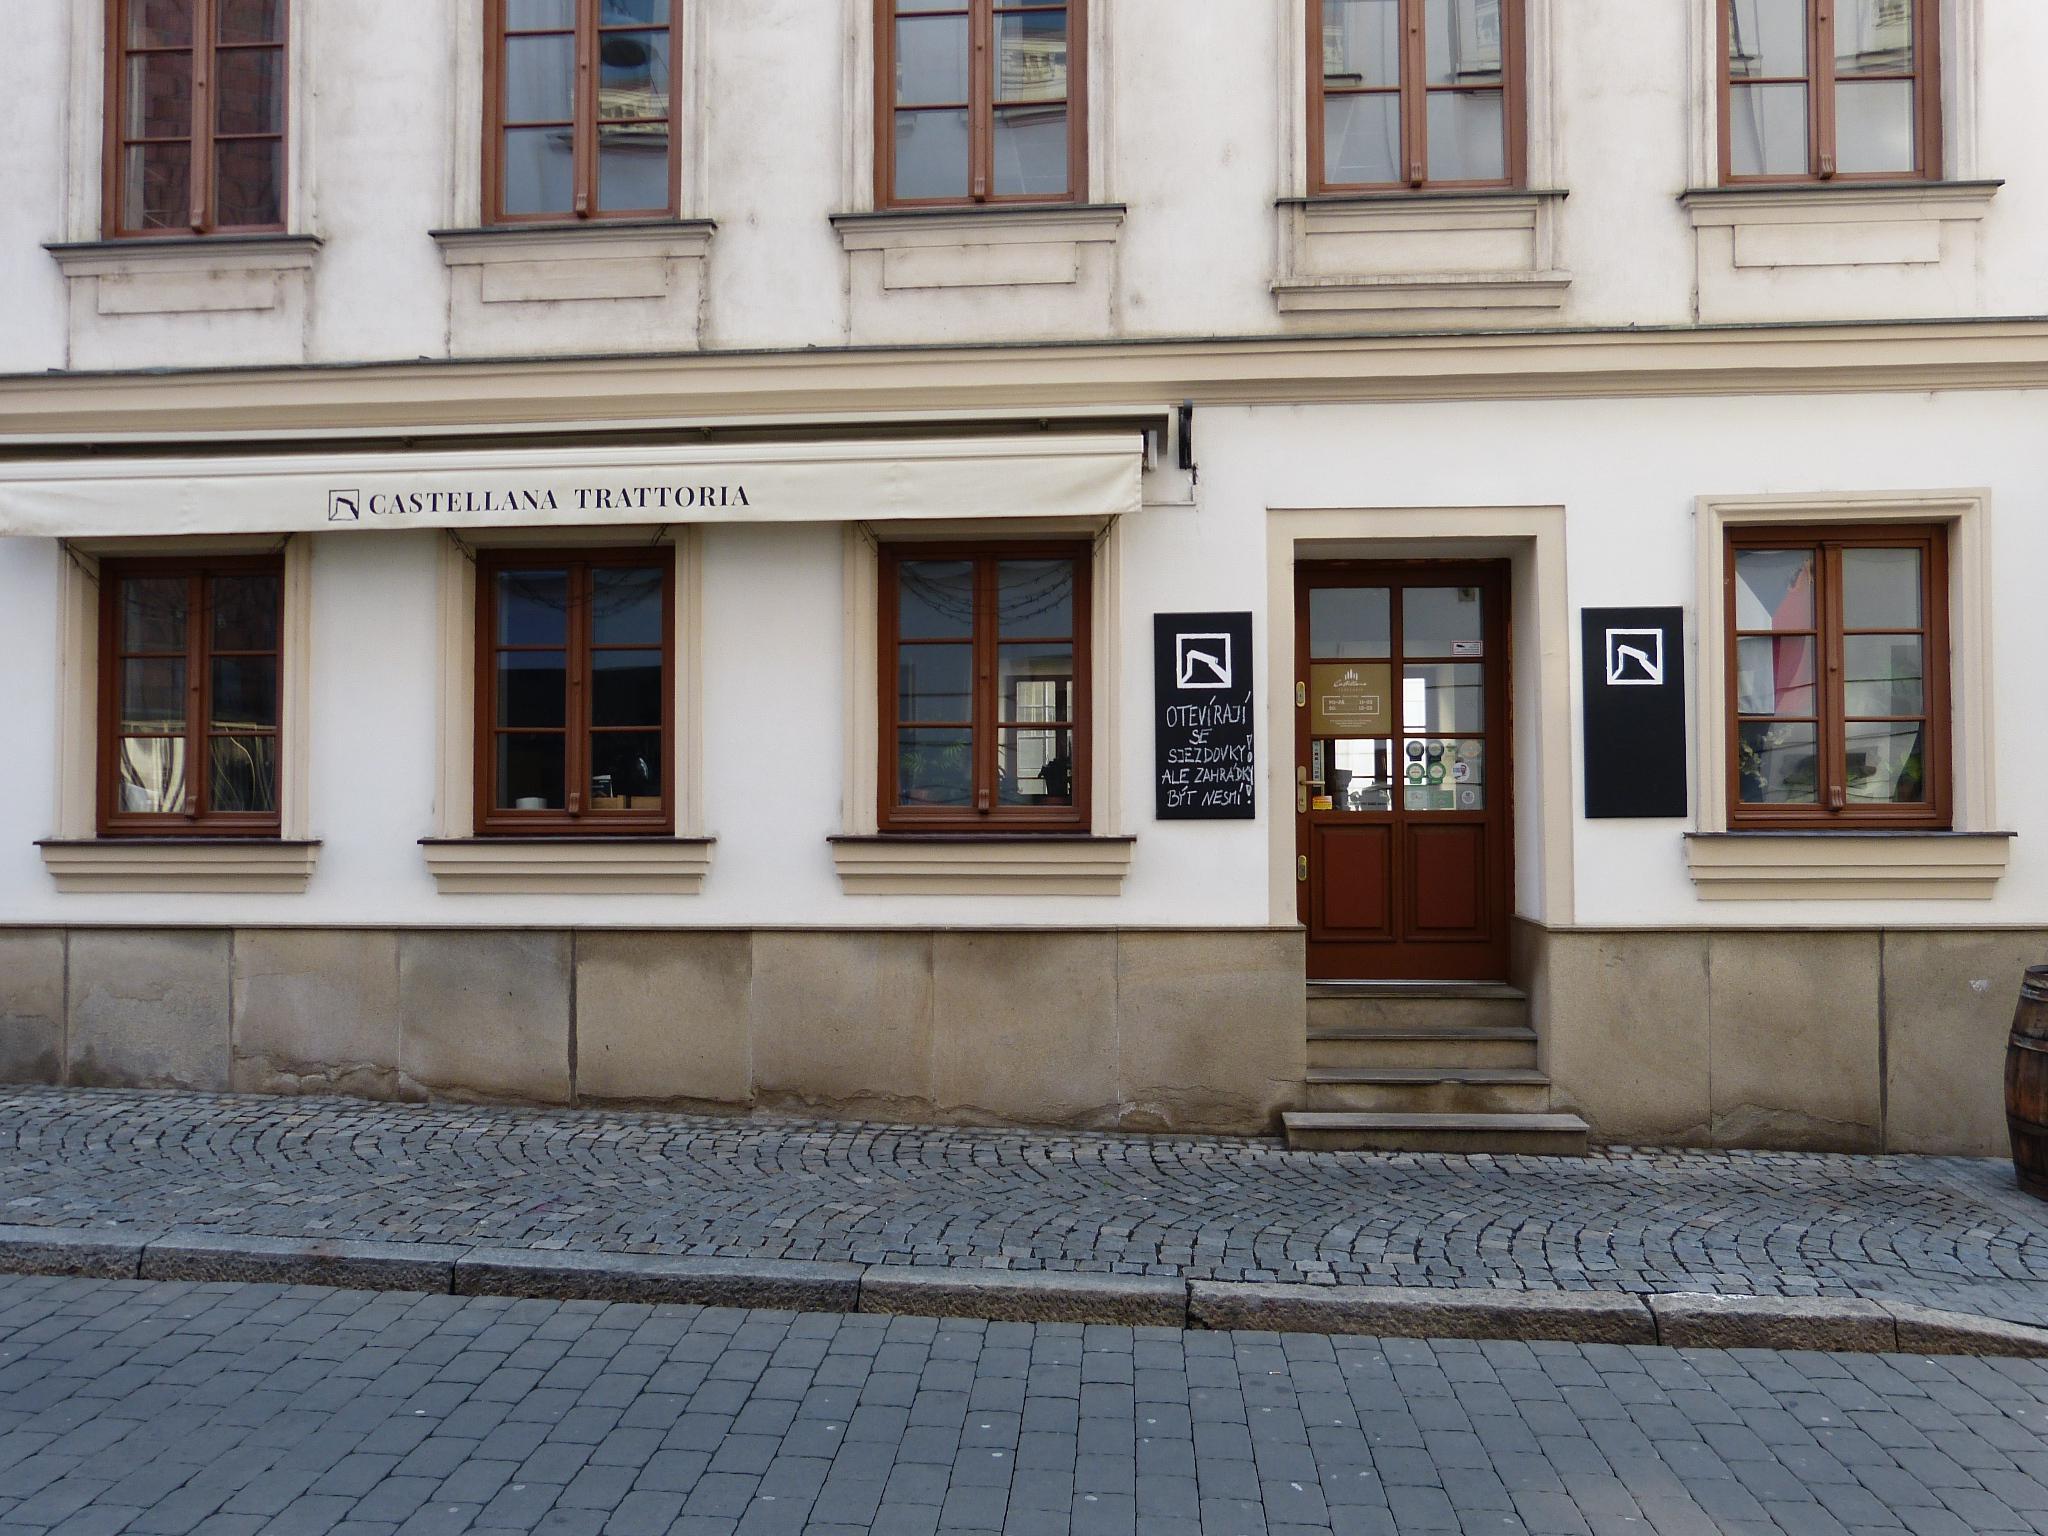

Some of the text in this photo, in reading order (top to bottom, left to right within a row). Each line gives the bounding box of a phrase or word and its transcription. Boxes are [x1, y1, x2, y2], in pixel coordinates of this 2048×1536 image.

[369, 485, 750, 514] CASTELLANA TRATTORIA
[1166, 690, 1251, 727] OTEVÍRAJÍ
[1189, 728, 1213, 745] SE
[1161, 762, 1254, 786] ALE ZAHRÁDKY
[1167, 785, 1198, 807] BÝT
